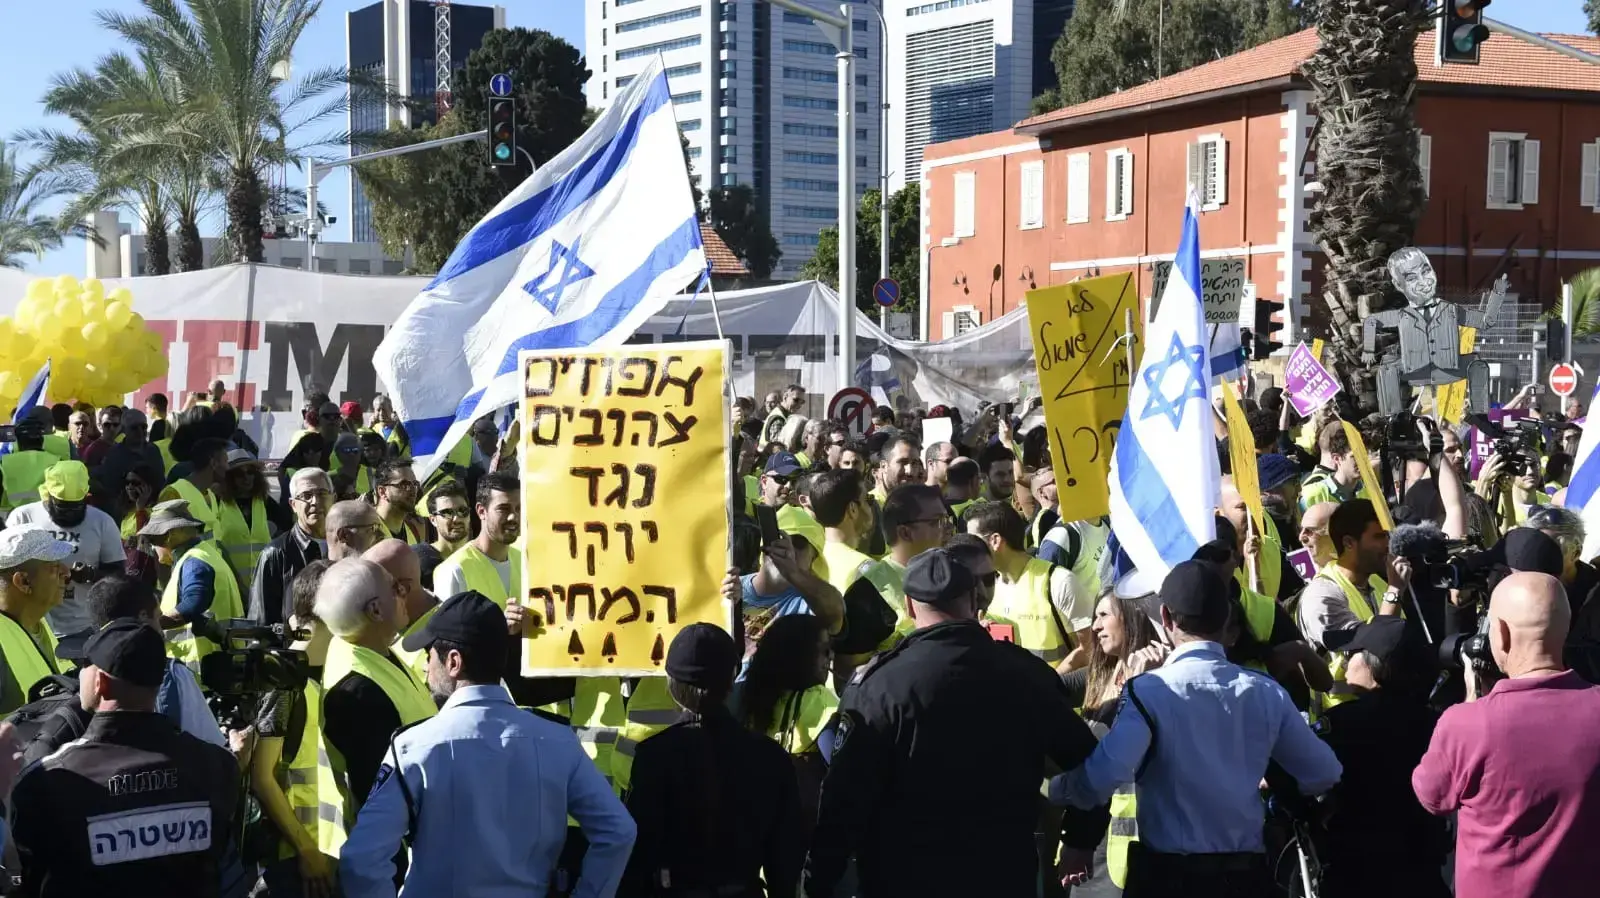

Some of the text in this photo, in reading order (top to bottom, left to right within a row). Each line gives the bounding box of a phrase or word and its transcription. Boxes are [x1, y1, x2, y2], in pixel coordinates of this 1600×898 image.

[1066, 289, 1094, 318] לא
[1040, 321, 1092, 371] שמאל
[531, 403, 699, 448] צהובים
[569, 462, 657, 509] נגד
[551, 520, 659, 577] יוקר
[529, 583, 677, 626] המחיה
[95, 819, 209, 854] משטרה
